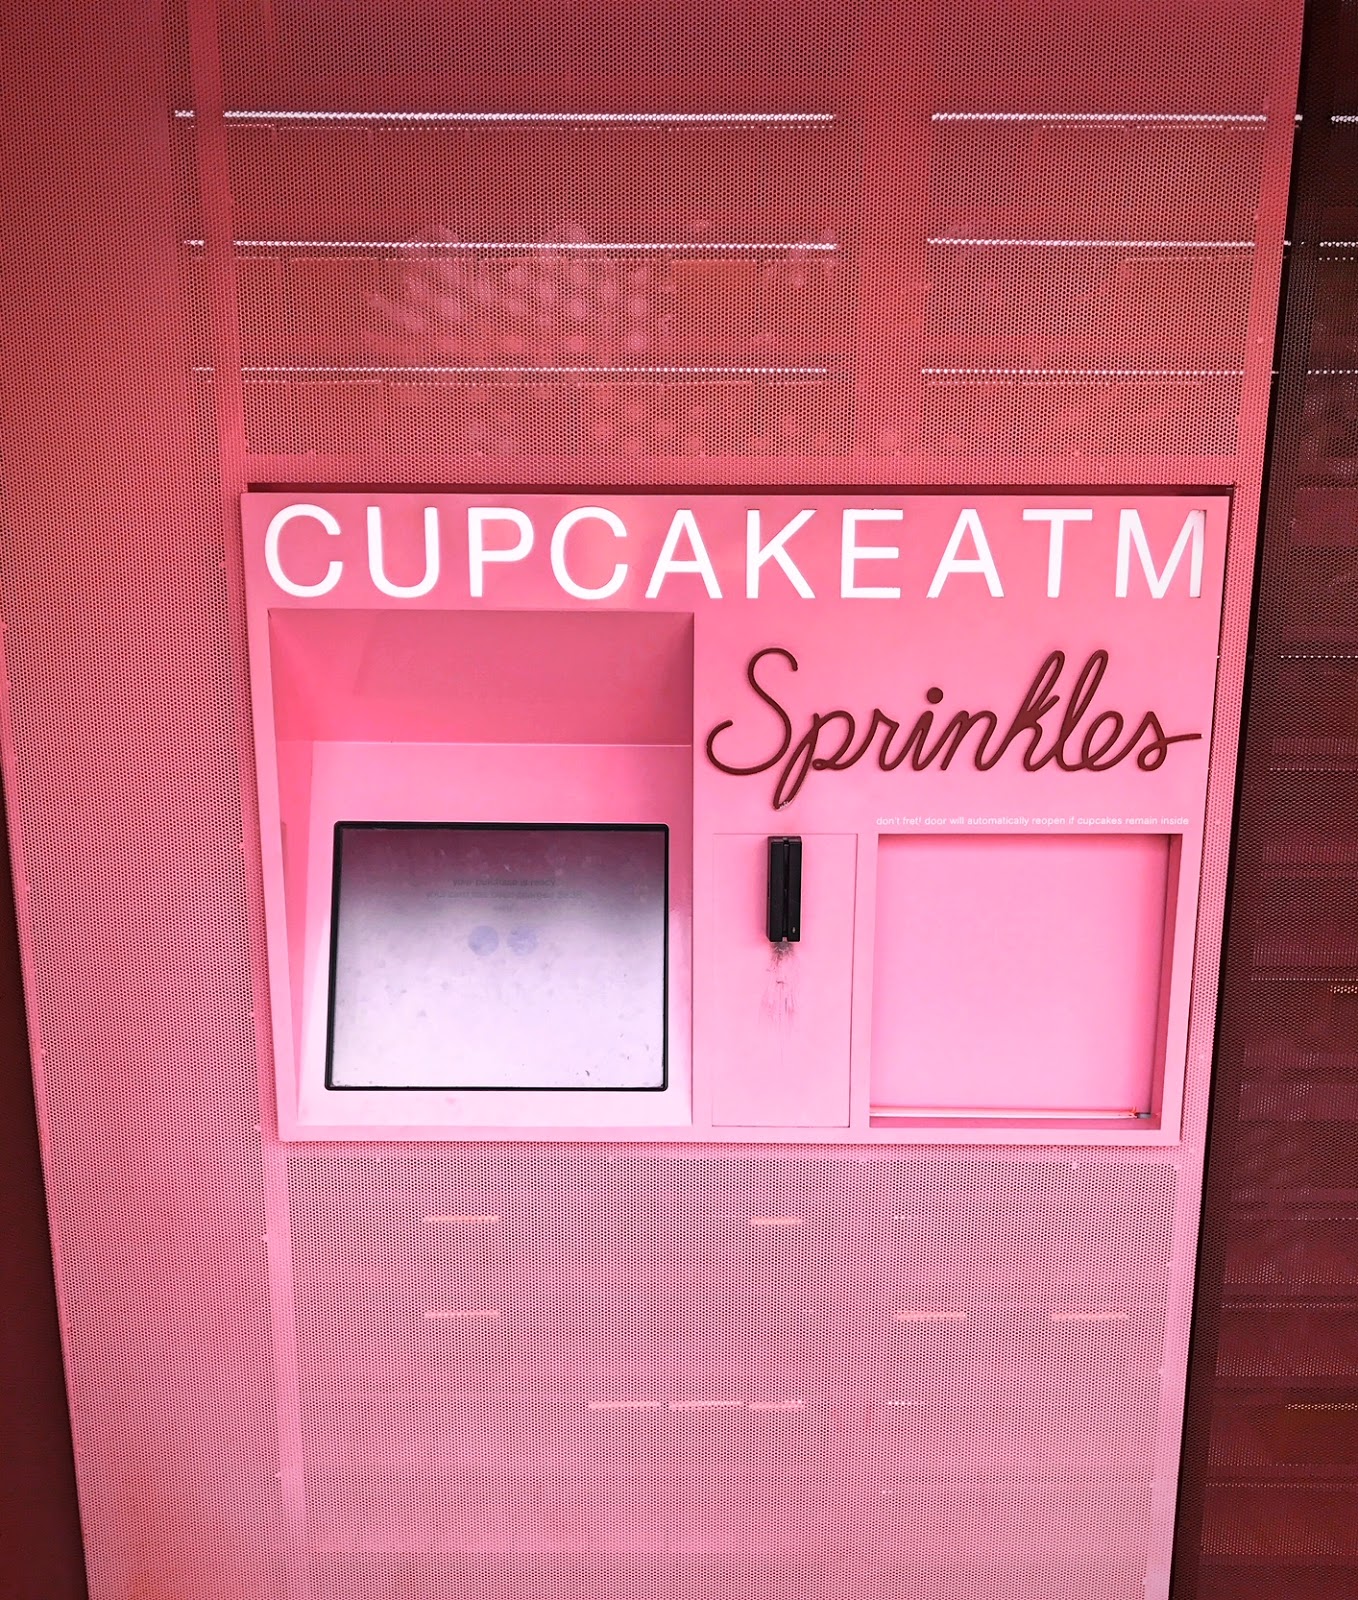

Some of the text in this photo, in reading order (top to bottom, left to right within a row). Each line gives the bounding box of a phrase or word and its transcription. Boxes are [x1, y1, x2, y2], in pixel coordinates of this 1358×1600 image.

[705, 647, 1203, 811] Sprinkles
[876, 816, 900, 826] don't
[924, 816, 947, 826] door
[949, 816, 965, 826] will
[967, 816, 1030, 827] automatically
[1031, 817, 1066, 827] reopen
[1068, 816, 1075, 826] if
[1077, 816, 1123, 827] cupcakes
[1125, 816, 1158, 826] remain
[1160, 816, 1190, 826] inside
